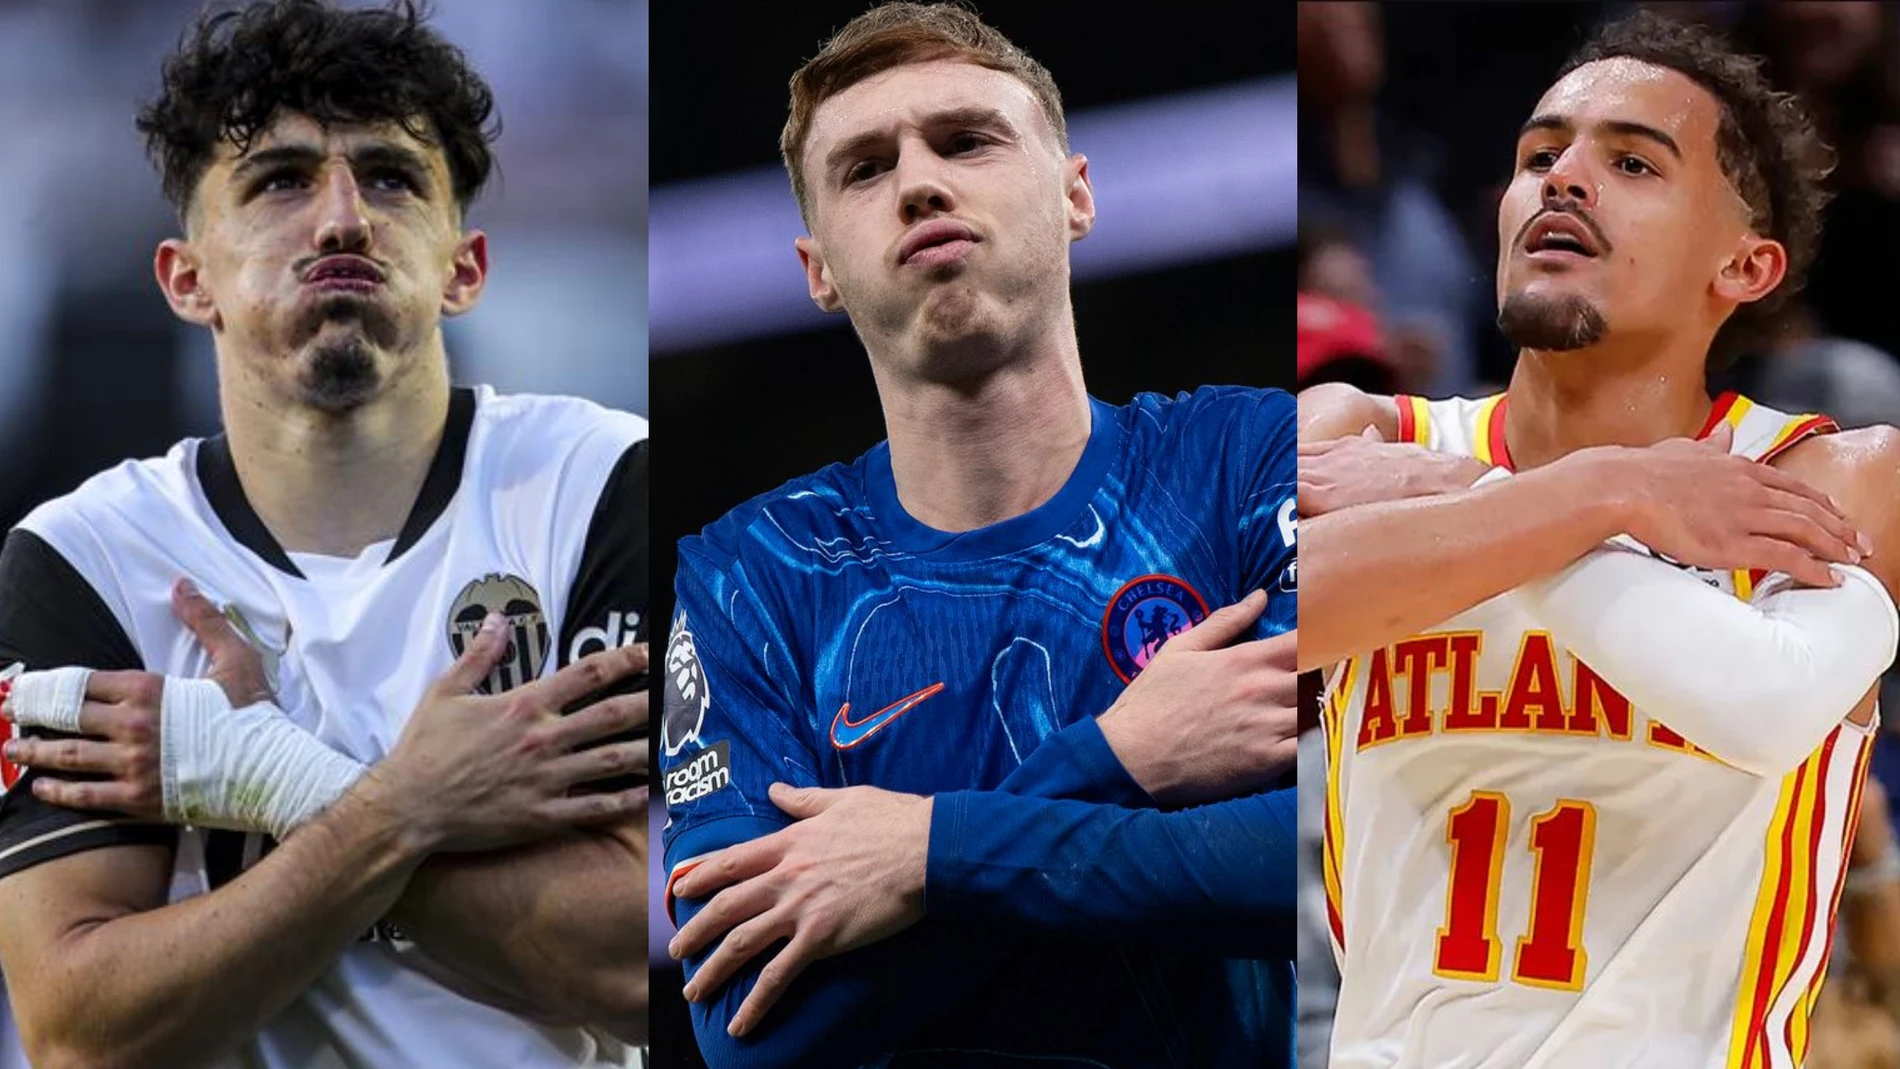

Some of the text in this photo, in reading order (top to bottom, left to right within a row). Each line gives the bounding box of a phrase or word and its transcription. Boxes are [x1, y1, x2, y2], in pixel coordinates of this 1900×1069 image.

[1117, 582, 1185, 612] CHELSEA
[1357, 630, 1722, 758] ATLAN
[666, 750, 719, 791] room
[1433, 789, 1597, 992] 11
